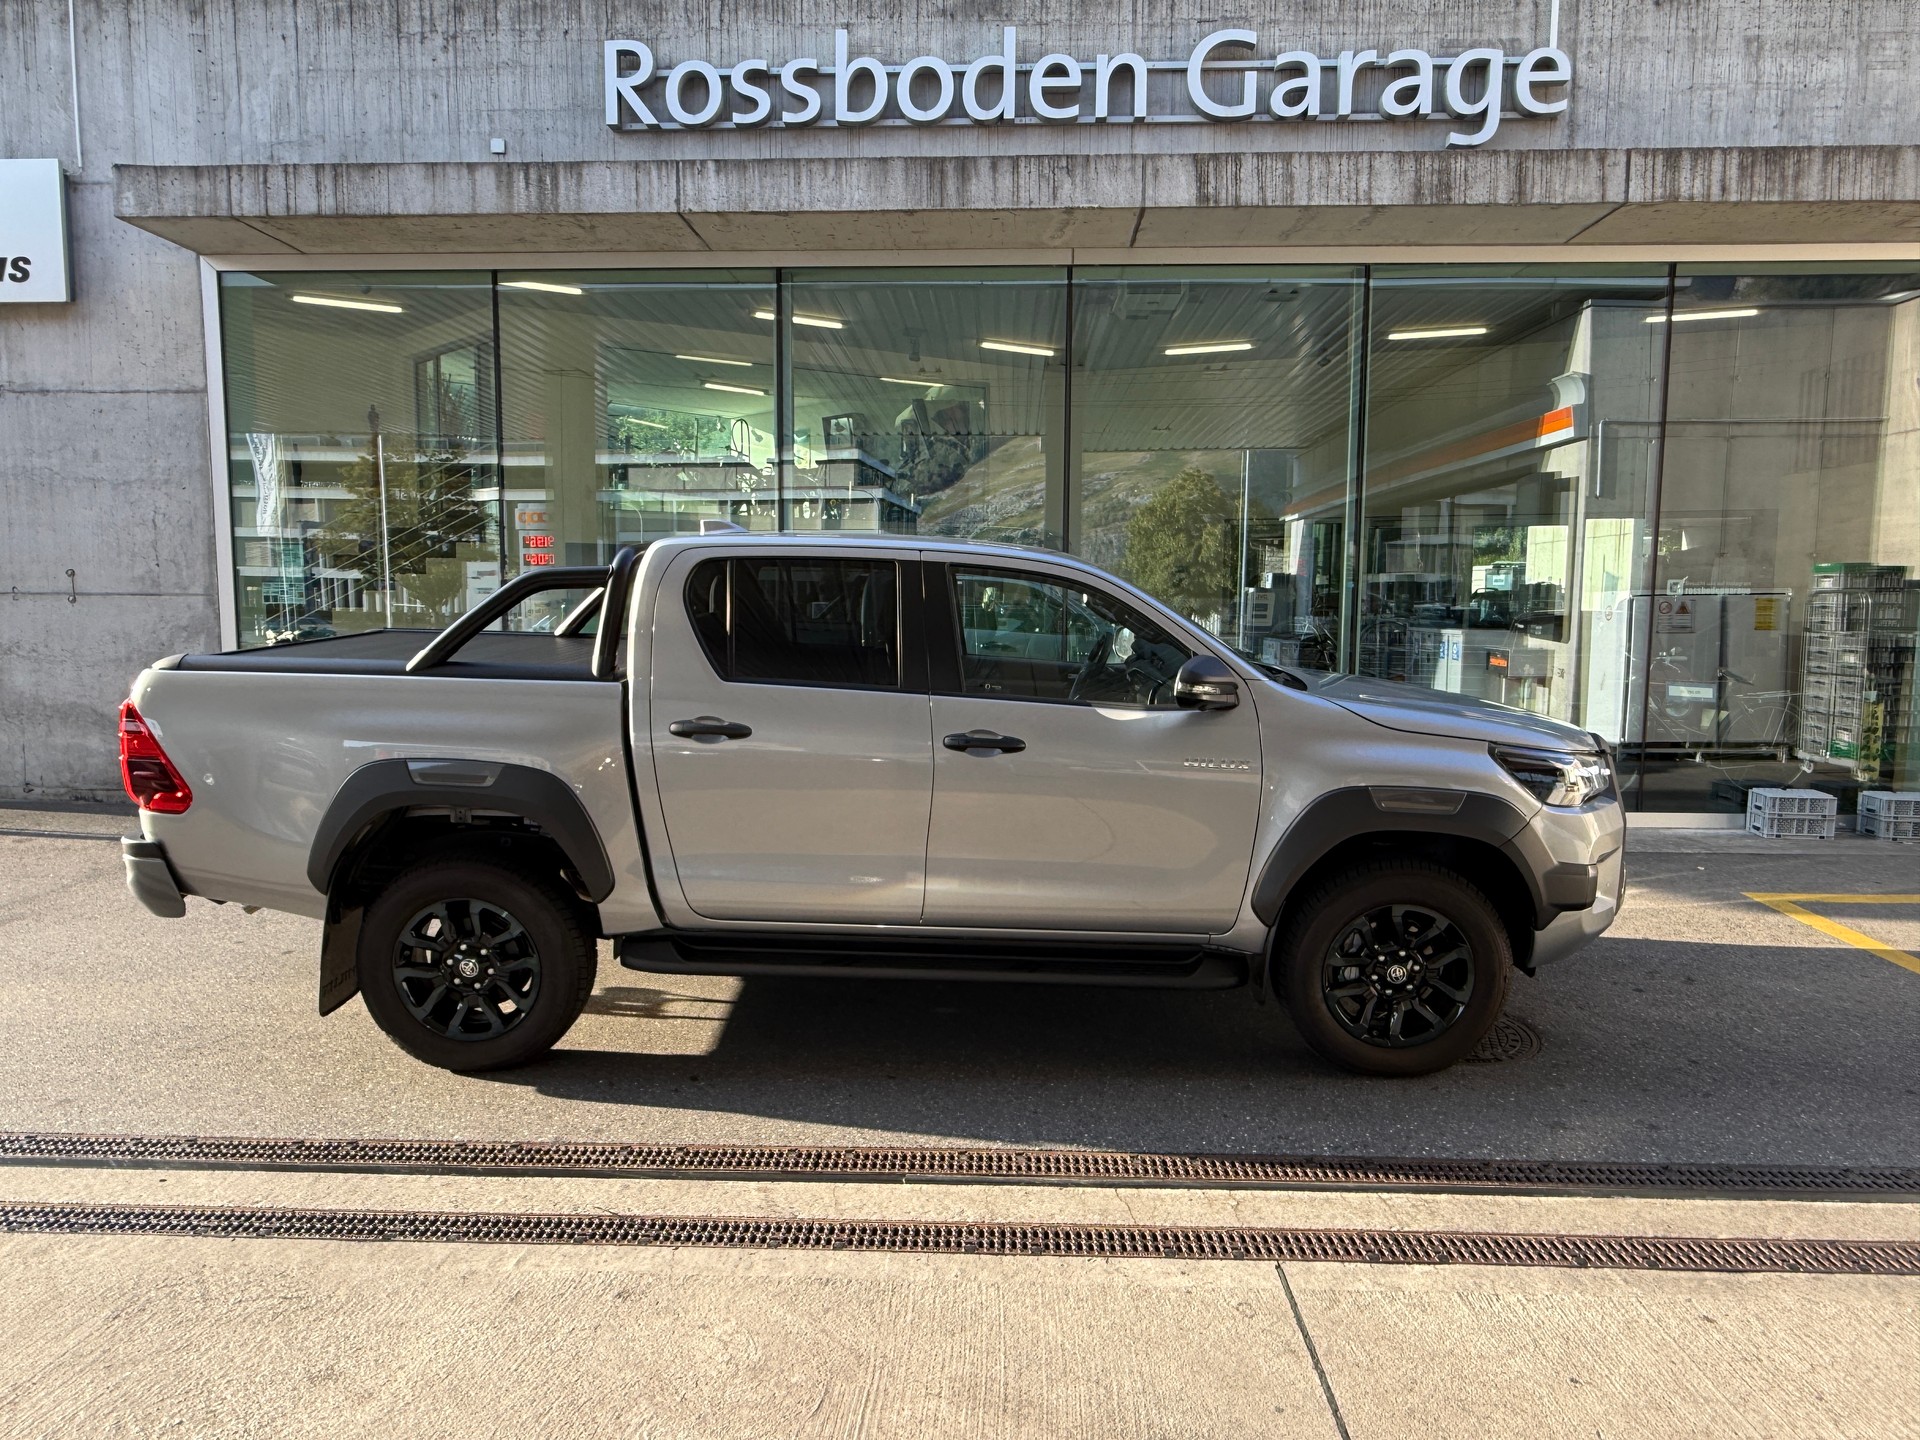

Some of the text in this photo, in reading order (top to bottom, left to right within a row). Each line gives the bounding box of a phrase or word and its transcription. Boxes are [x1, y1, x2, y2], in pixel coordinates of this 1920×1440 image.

[604, 26, 1571, 148] Rossboden Garage
[1183, 757, 1251, 770] HILUX
